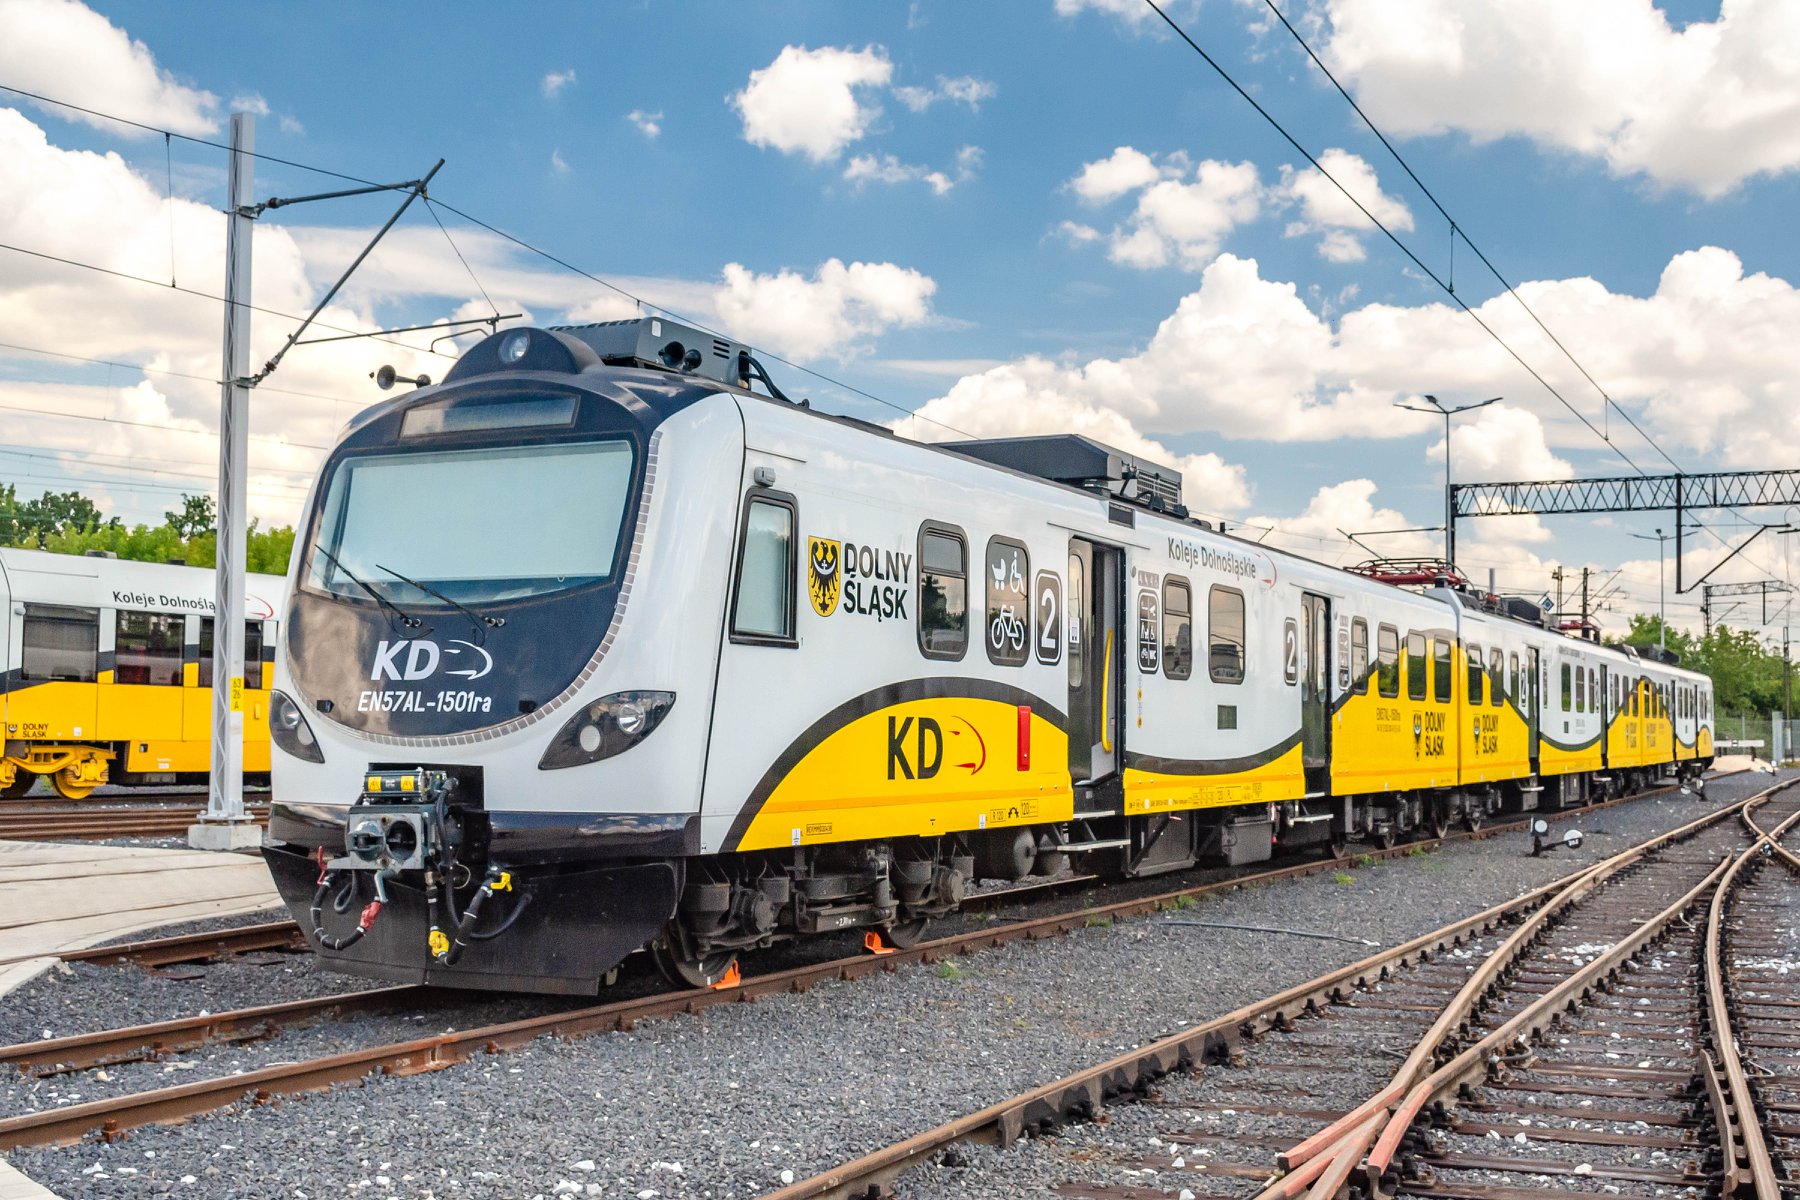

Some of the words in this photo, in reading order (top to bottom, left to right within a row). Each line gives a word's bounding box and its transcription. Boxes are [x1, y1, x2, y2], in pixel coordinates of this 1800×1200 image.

[844, 542, 913, 584] DOLNY
[1167, 537, 1199, 569] Koleje
[1201, 546, 1256, 581] Dolnośląskie
[112, 591, 156, 607] Koleje
[160, 595, 216, 613] Dolnoślą
[843, 574, 908, 623] ŚLĄSK
[1041, 588, 1056, 649] 2
[371, 640, 440, 680] KD
[1286, 630, 1295, 673] 2
[357, 690, 492, 713] EN57AL-1501ra
[1425, 711, 1446, 732] DOLNY
[22, 723, 48, 731] DOLNY
[1482, 715, 1498, 733] DOLNY
[888, 716, 943, 780] KD
